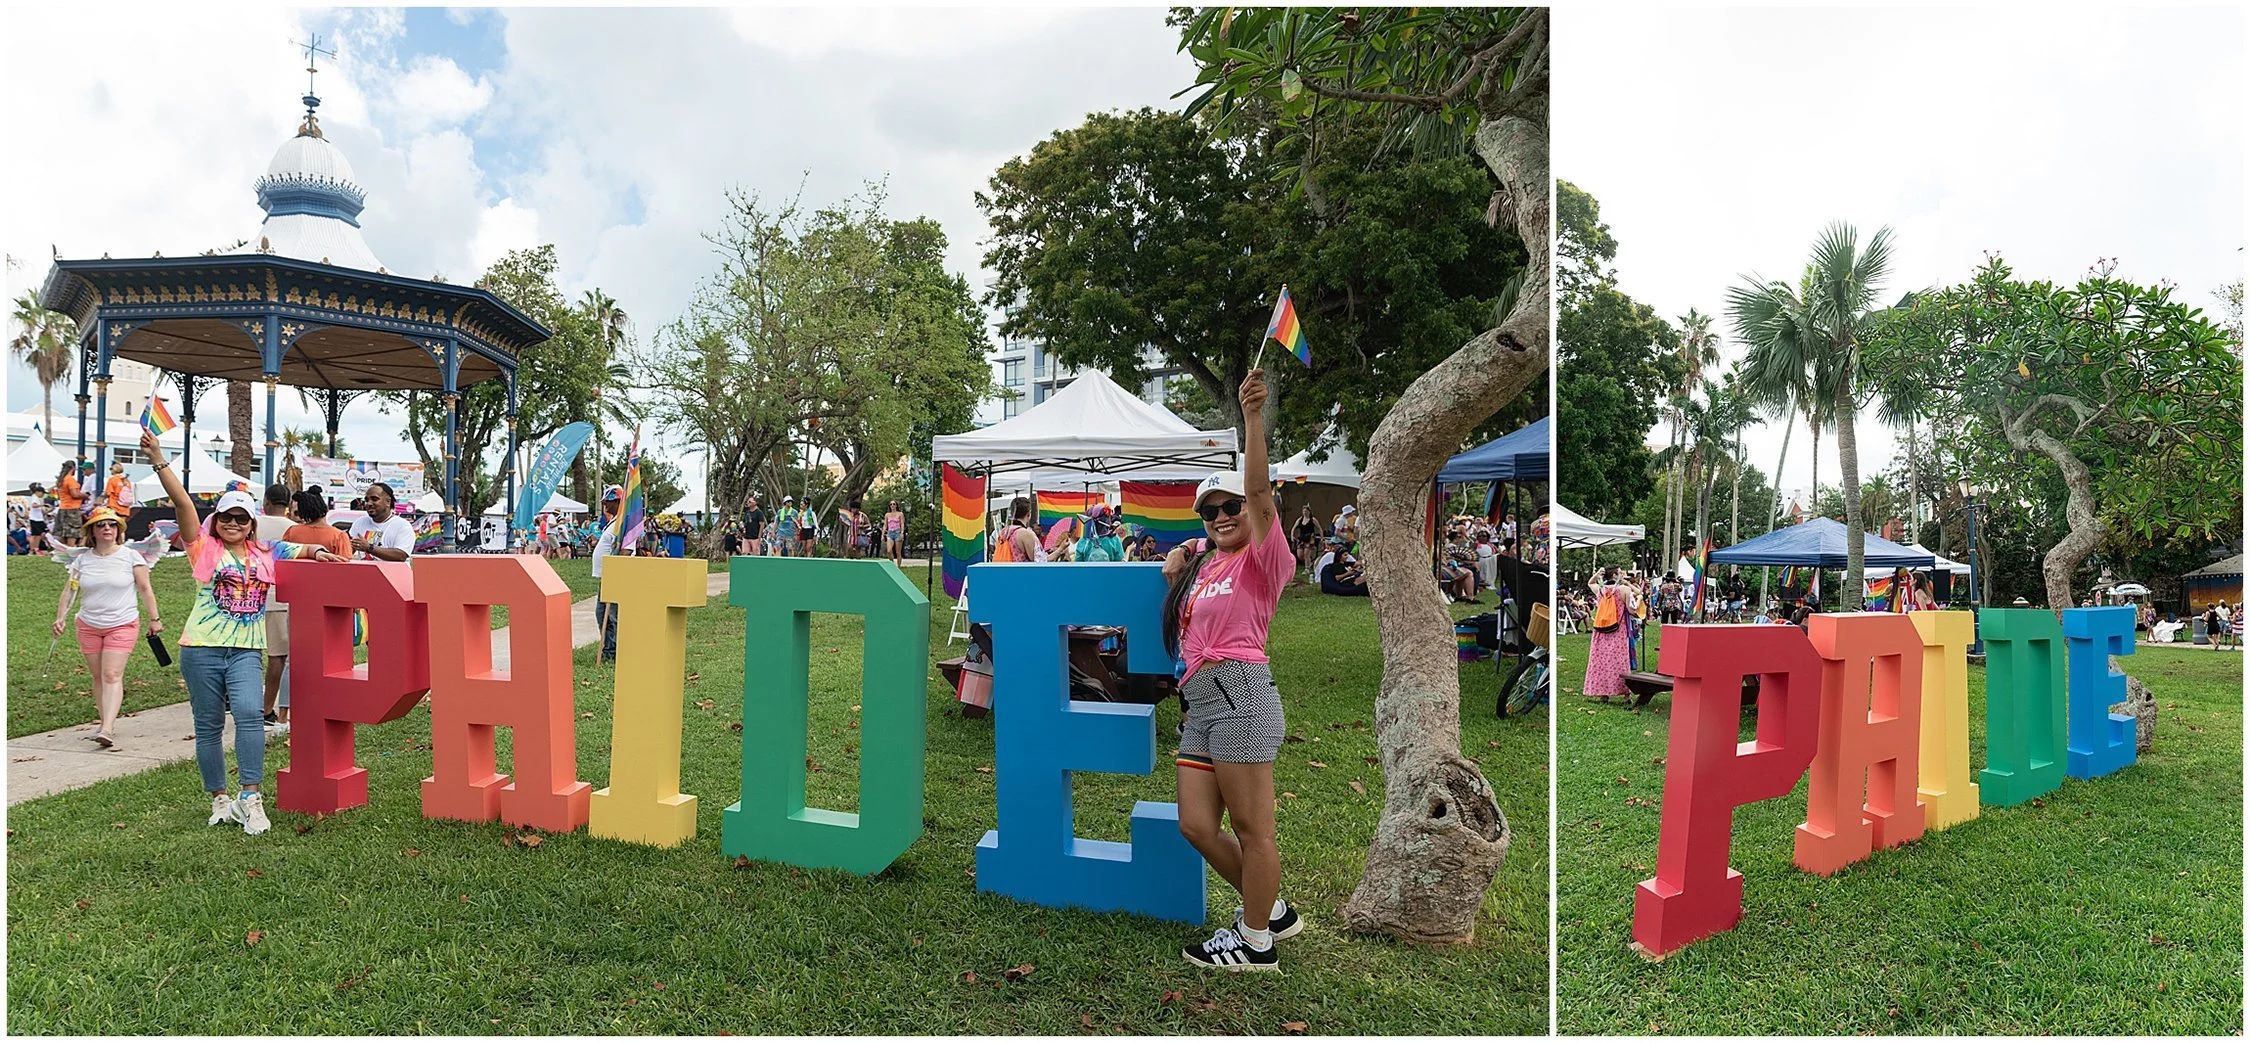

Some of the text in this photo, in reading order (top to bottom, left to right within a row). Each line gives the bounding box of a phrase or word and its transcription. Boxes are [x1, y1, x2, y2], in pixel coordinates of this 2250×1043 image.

[533, 443, 568, 495] RENTALS
[276, 553, 1206, 926] PRIDE
[1632, 606, 2136, 954] PRIDE
